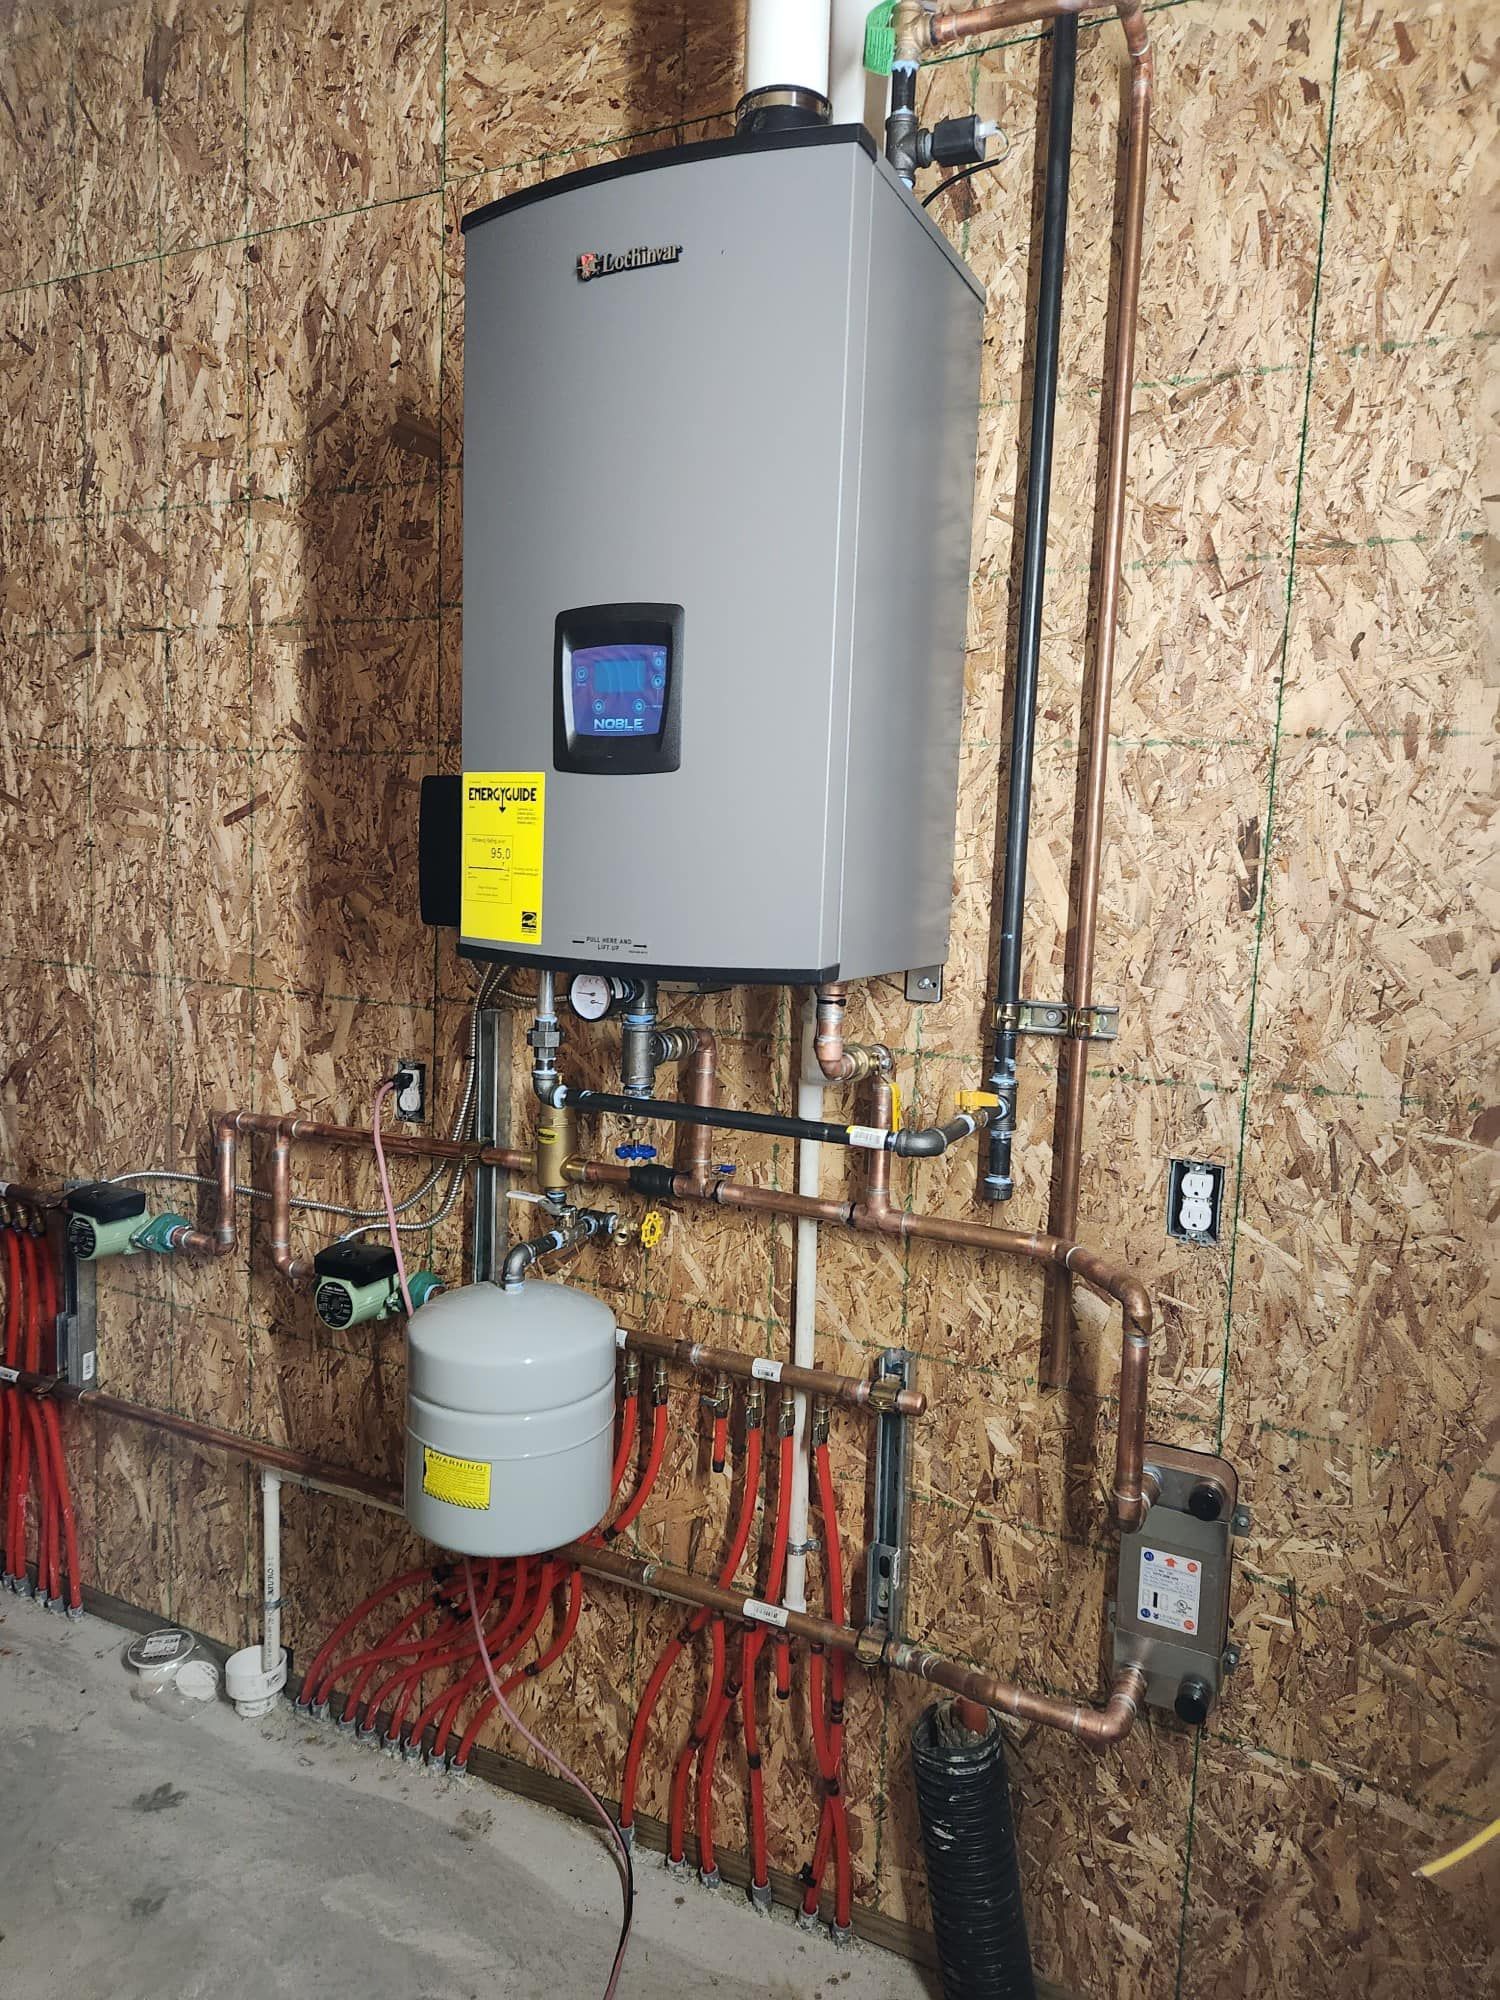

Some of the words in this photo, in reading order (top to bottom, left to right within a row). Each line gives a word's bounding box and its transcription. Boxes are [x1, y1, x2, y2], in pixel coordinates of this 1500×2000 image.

[602, 244, 678, 273] Lochinvar
[593, 718, 645, 730] NOBLE
[468, 787, 537, 802] ENERGYGUIDE
[602, 937, 618, 945] HERE
